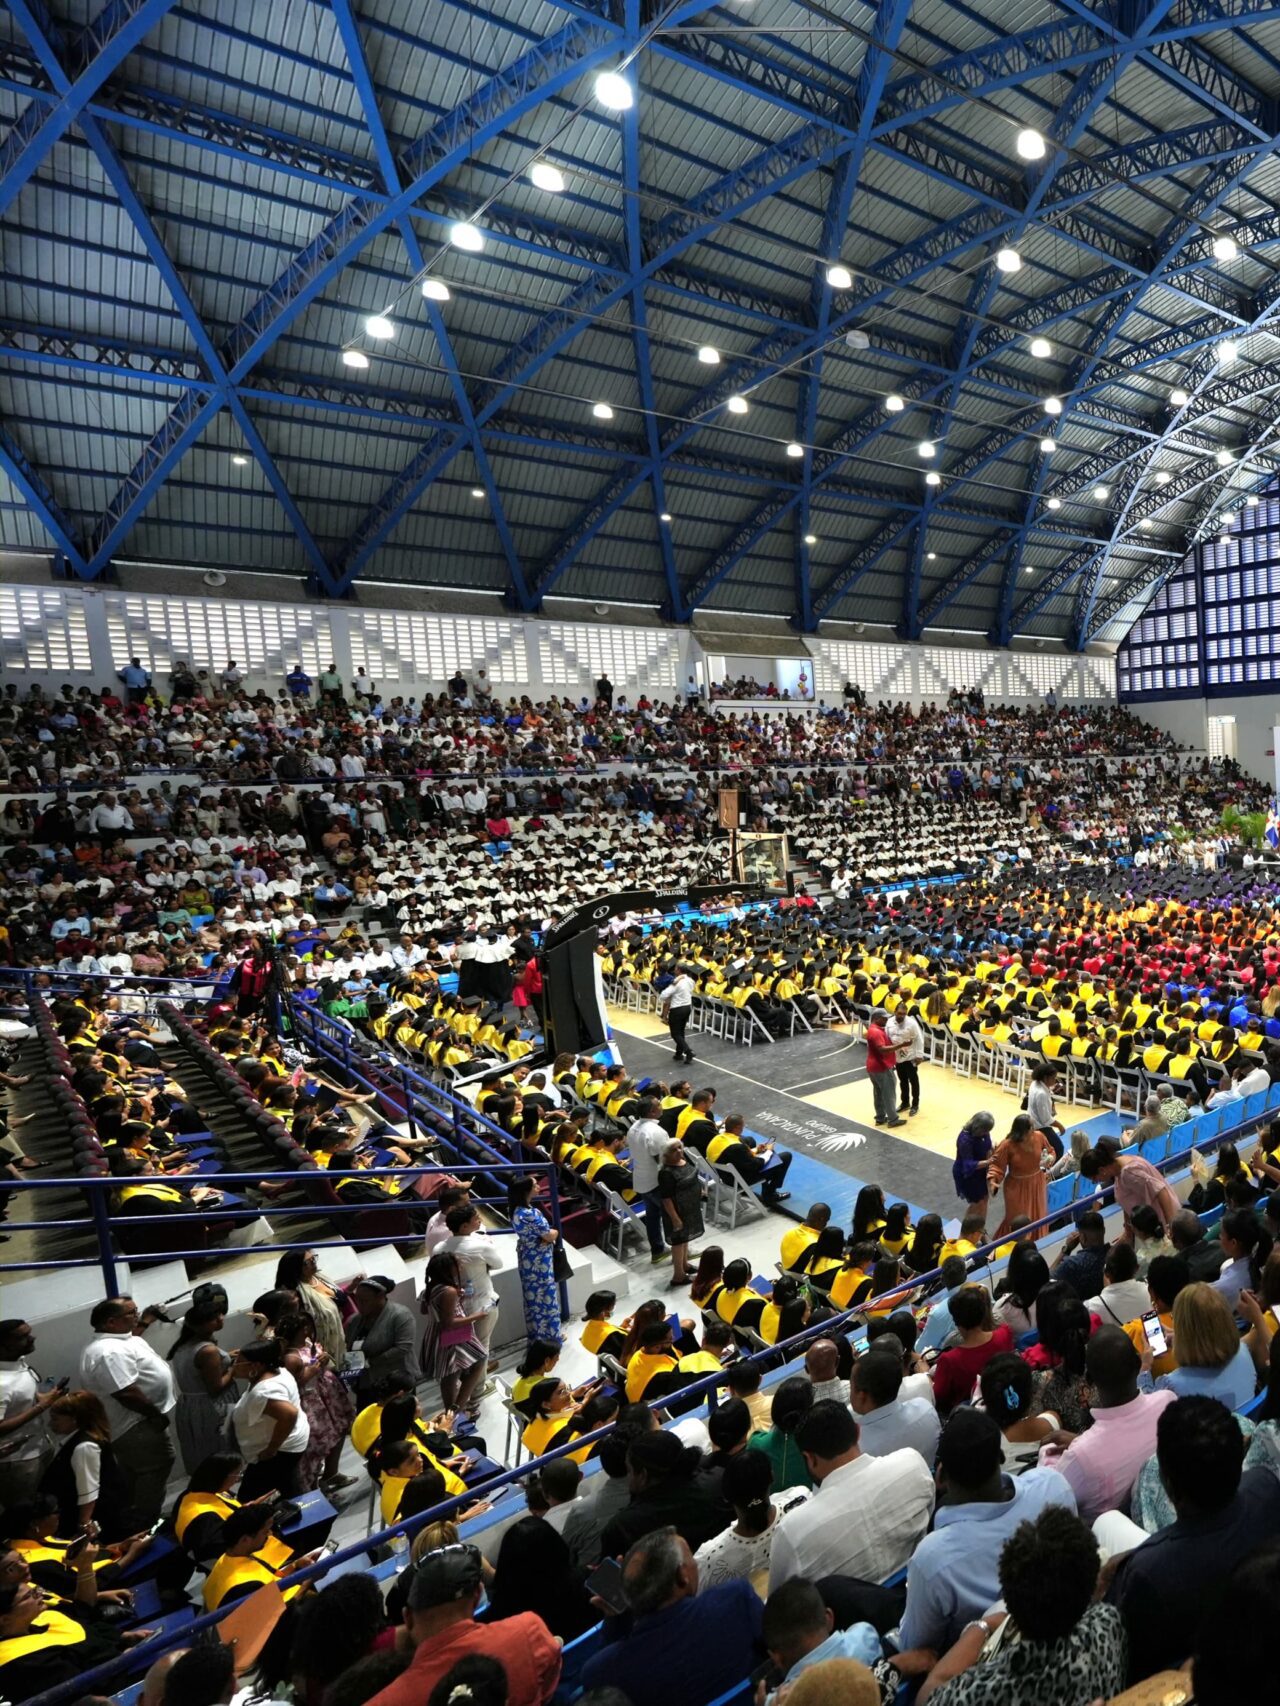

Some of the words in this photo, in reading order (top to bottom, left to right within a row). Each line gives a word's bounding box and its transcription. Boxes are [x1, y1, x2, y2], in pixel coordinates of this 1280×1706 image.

[655, 888, 688, 898] SPALDING
[552, 910, 579, 933] SPALDING
[755, 1110, 822, 1140] PUNTACANA
[805, 1119, 837, 1133] GRUPO
